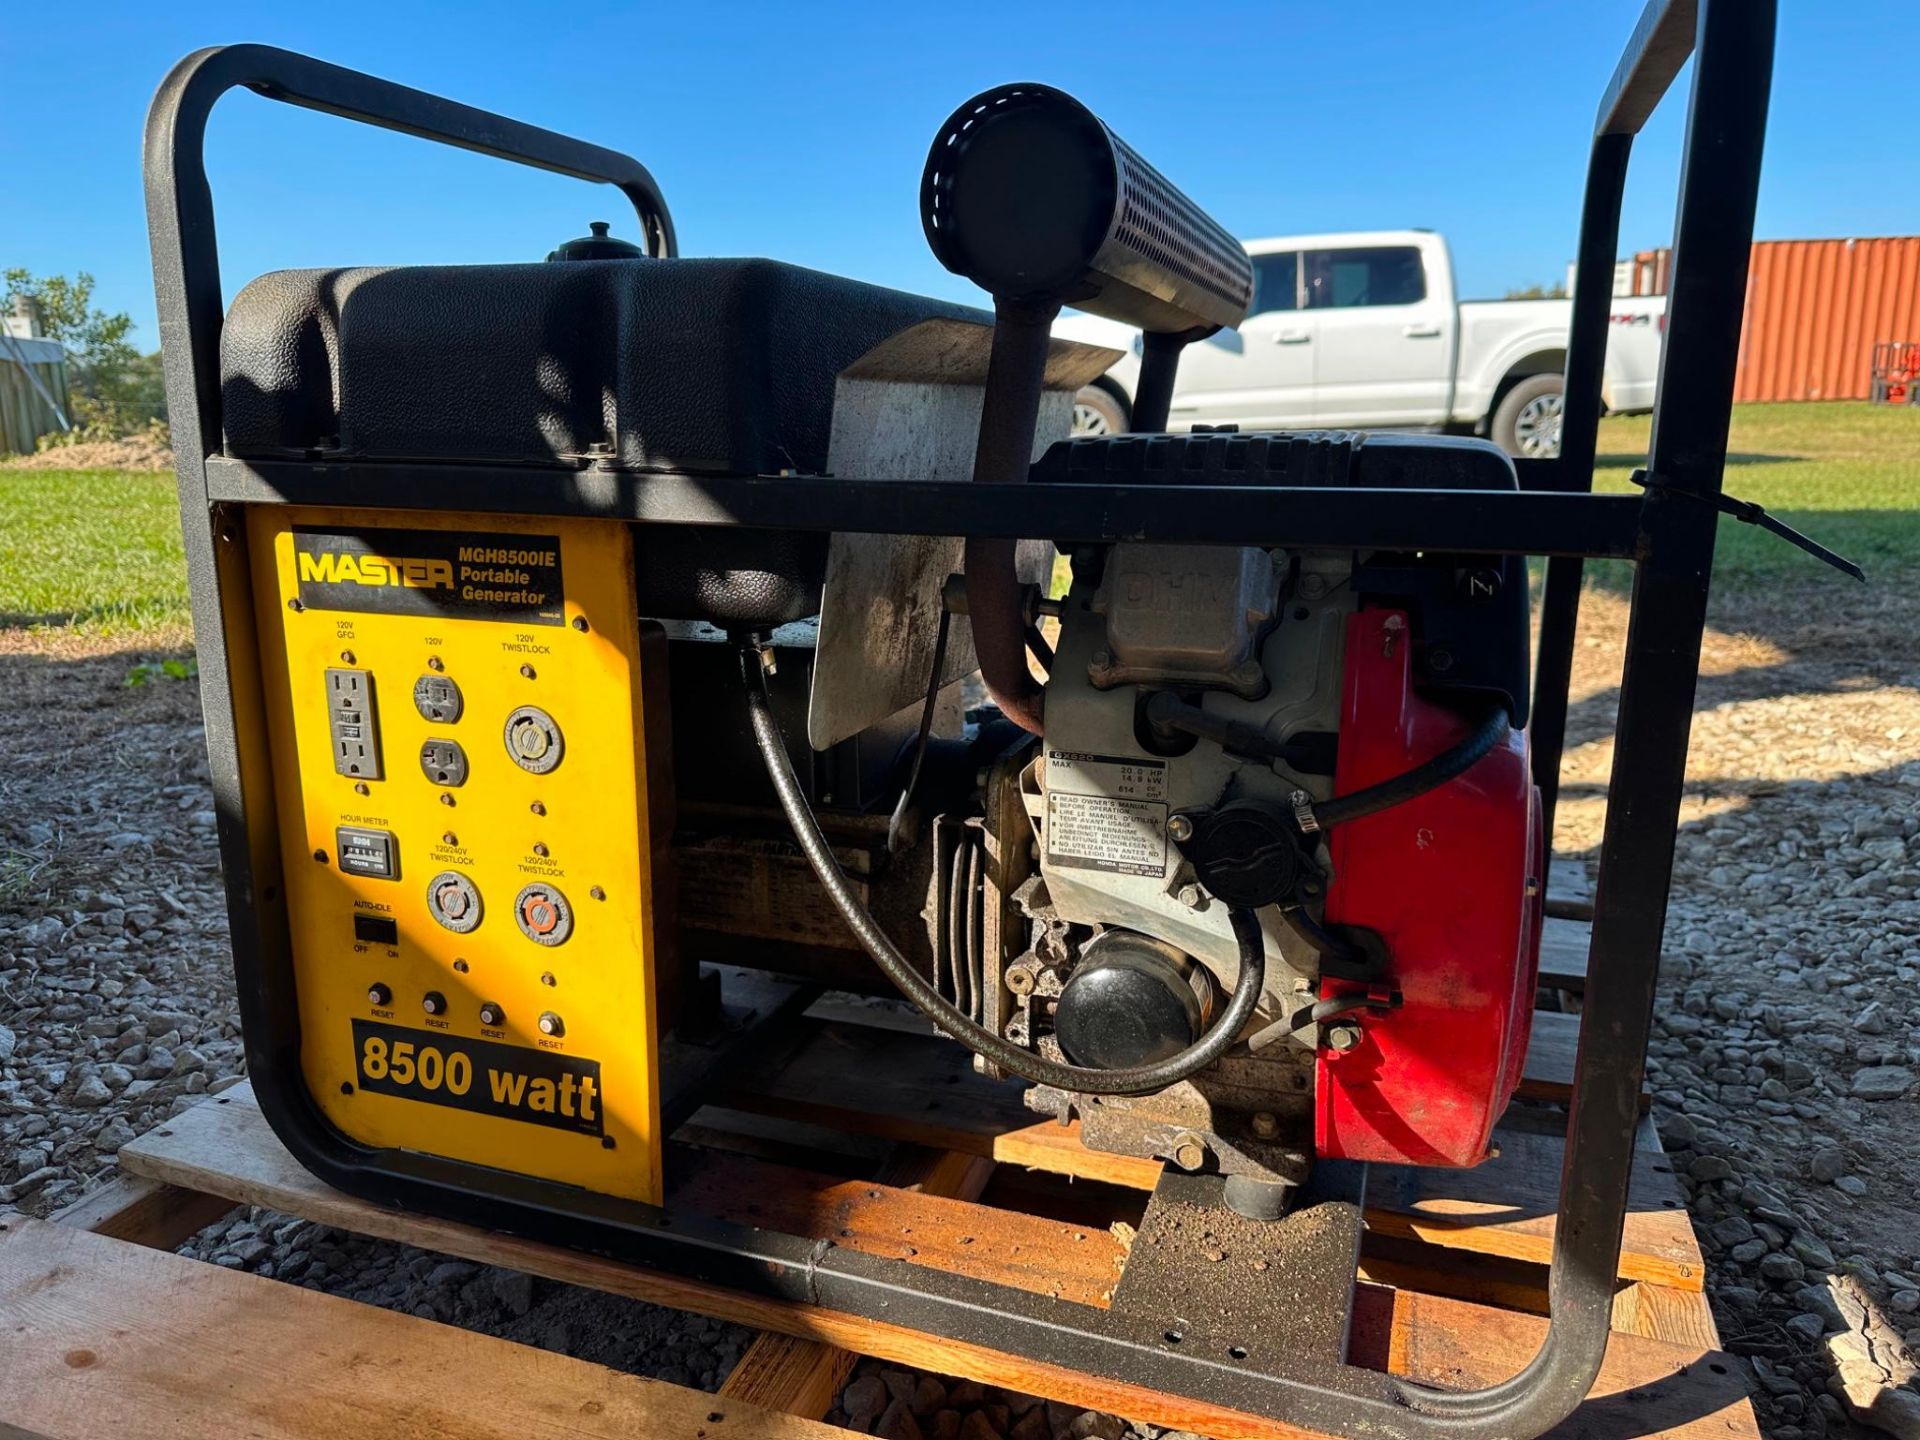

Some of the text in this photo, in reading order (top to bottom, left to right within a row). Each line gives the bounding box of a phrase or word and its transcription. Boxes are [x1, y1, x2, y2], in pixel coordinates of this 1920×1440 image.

[458, 547, 556, 567] MGH8500IE
[299, 552, 454, 589] MASTER
[460, 567, 530, 585] Portable
[462, 585, 546, 605] Generator
[336, 621, 354, 630] 120V
[337, 631, 355, 640] GFCI
[515, 633, 535, 644] 120V
[424, 637, 443, 646] 120V
[502, 643, 551, 655] TWISTLOCK
[1052, 760, 1072, 769] MAX
[1150, 769, 1162, 777] HP
[1147, 776, 1162, 784] kW
[1060, 802, 1085, 810] BEFORE
[1081, 797, 1115, 807] OWNER'S
[1119, 800, 1149, 810] MANUAL
[340, 814, 389, 827] HOUR METER
[1080, 817, 1104, 825] AVANT
[1089, 812, 1118, 821] MANUEL
[435, 845, 467, 856] 120/240V
[430, 853, 475, 866] TWISTLOCK
[523, 856, 558, 867] 120/240V
[518, 864, 565, 877] TWISTLOCK
[354, 945, 368, 954] OFF
[388, 950, 399, 959] ON
[371, 1008, 395, 1020] RESET
[425, 1018, 450, 1030] RESET
[481, 1028, 506, 1040] RESET
[538, 1038, 564, 1050] RESET
[363, 1036, 597, 1121] 8500 watt
